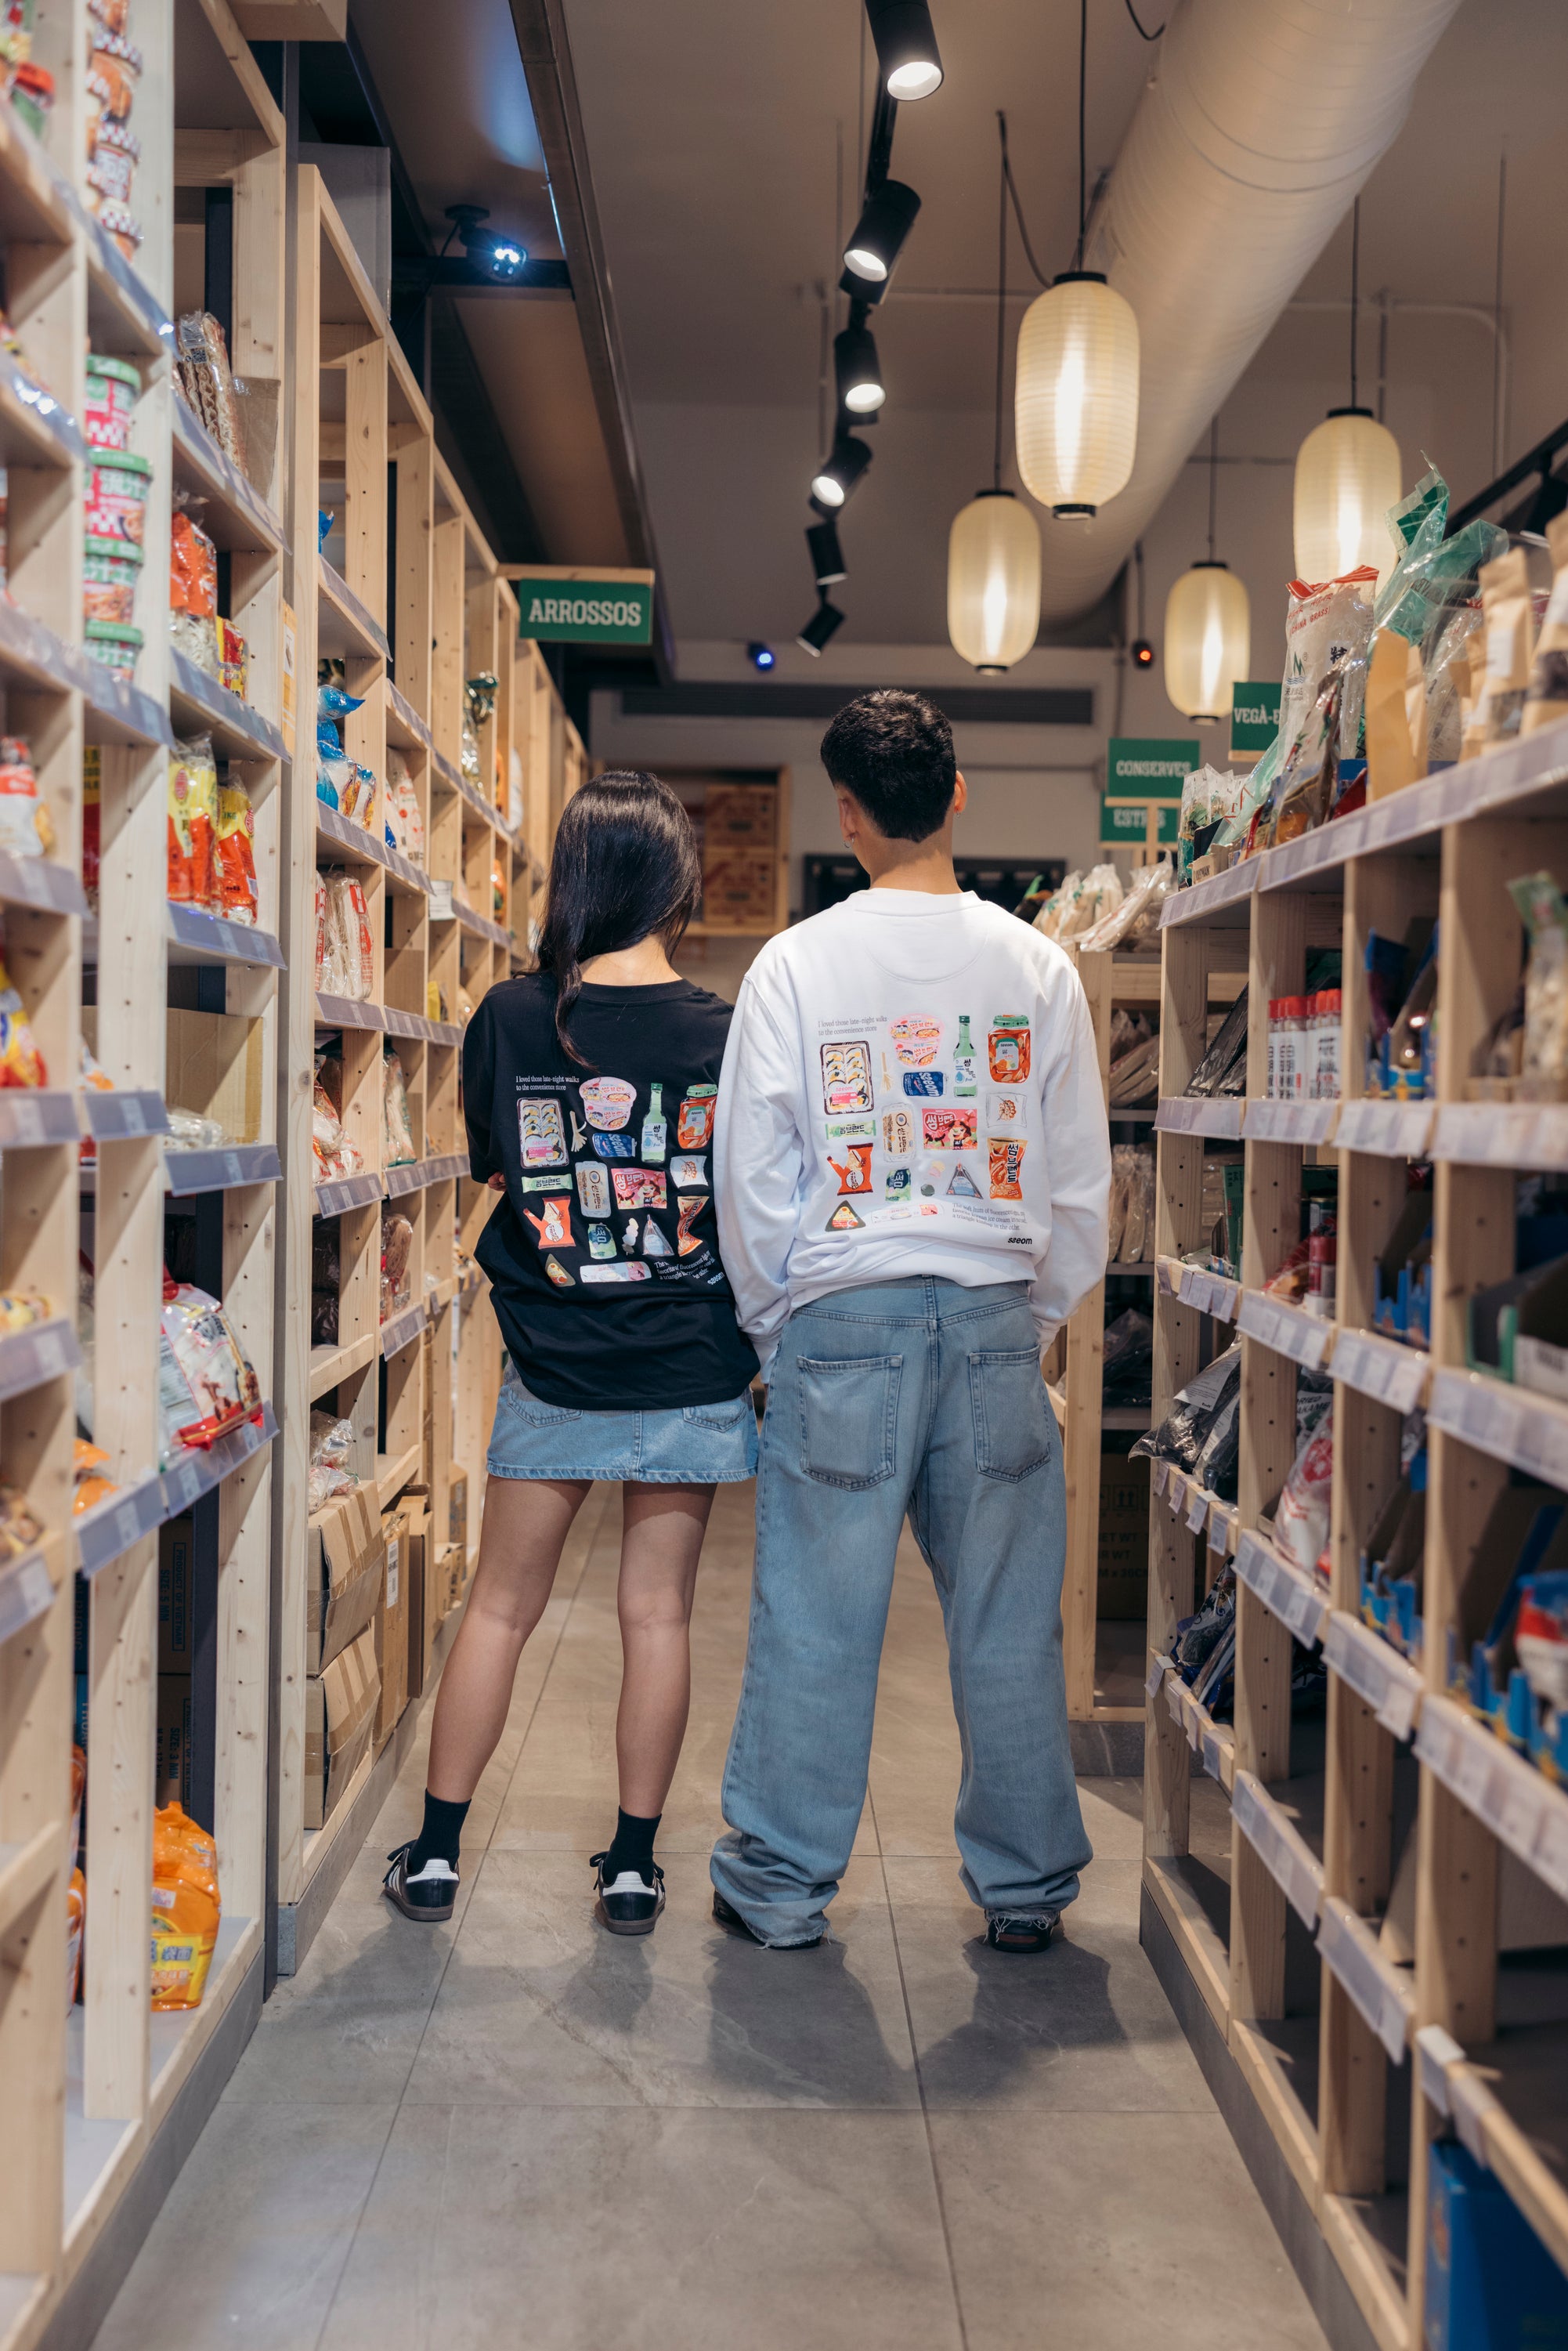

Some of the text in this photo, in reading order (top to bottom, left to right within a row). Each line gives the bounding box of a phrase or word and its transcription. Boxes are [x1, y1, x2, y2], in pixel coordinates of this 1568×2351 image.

[529, 598, 641, 627] ARROSSOS
[1116, 760, 1191, 777] CONSERVES
[850, 1016, 875, 1025] late-night
[1297, 1402, 1331, 1414] AKAME
[161, 1569, 169, 1593] SIZE:
[175, 1592, 182, 1603] OF
[170, 1727, 180, 1751] SIZE:
[168, 1763, 179, 1780] MM
